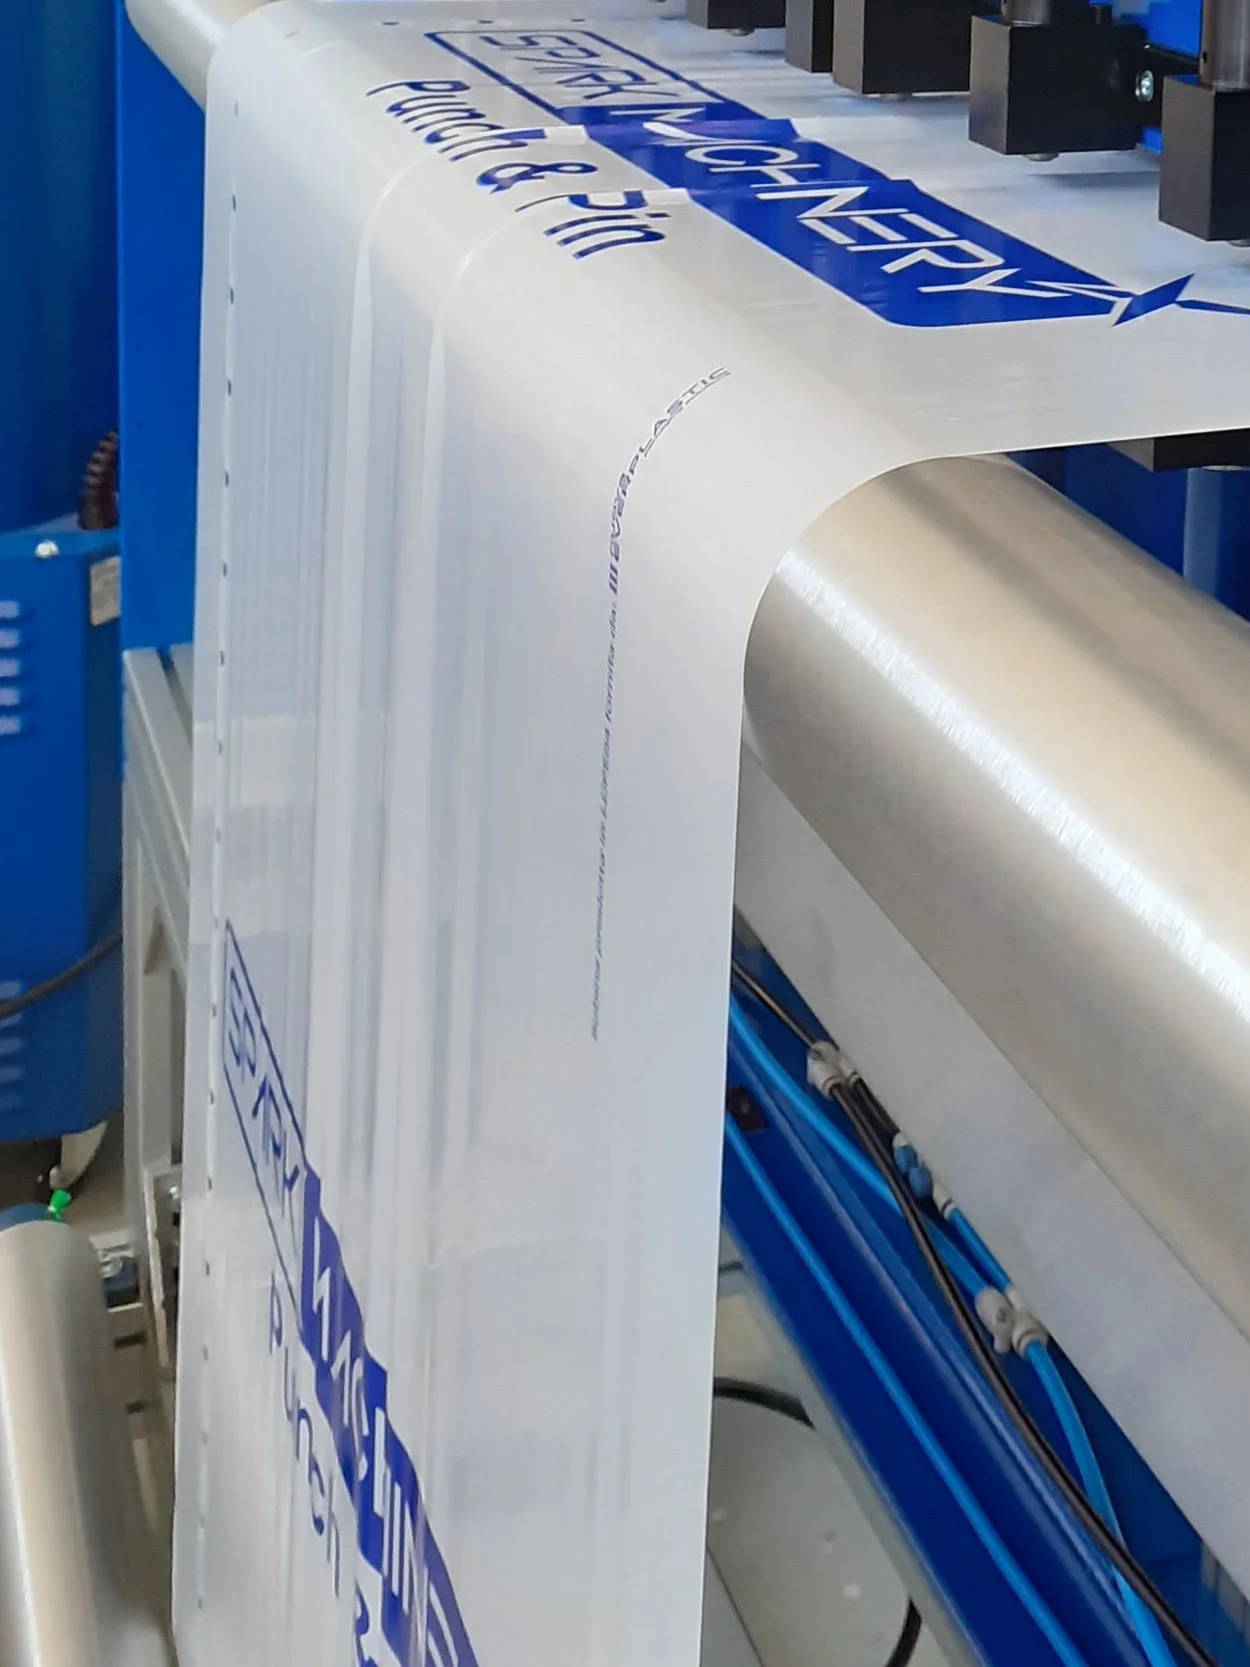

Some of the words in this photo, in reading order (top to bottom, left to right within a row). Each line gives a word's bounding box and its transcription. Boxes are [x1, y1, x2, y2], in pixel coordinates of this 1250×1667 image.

[479, 33, 680, 100] SPARK
[366, 79, 548, 163] Punch
[476, 161, 599, 195] &
[514, 189, 671, 261] Pin
